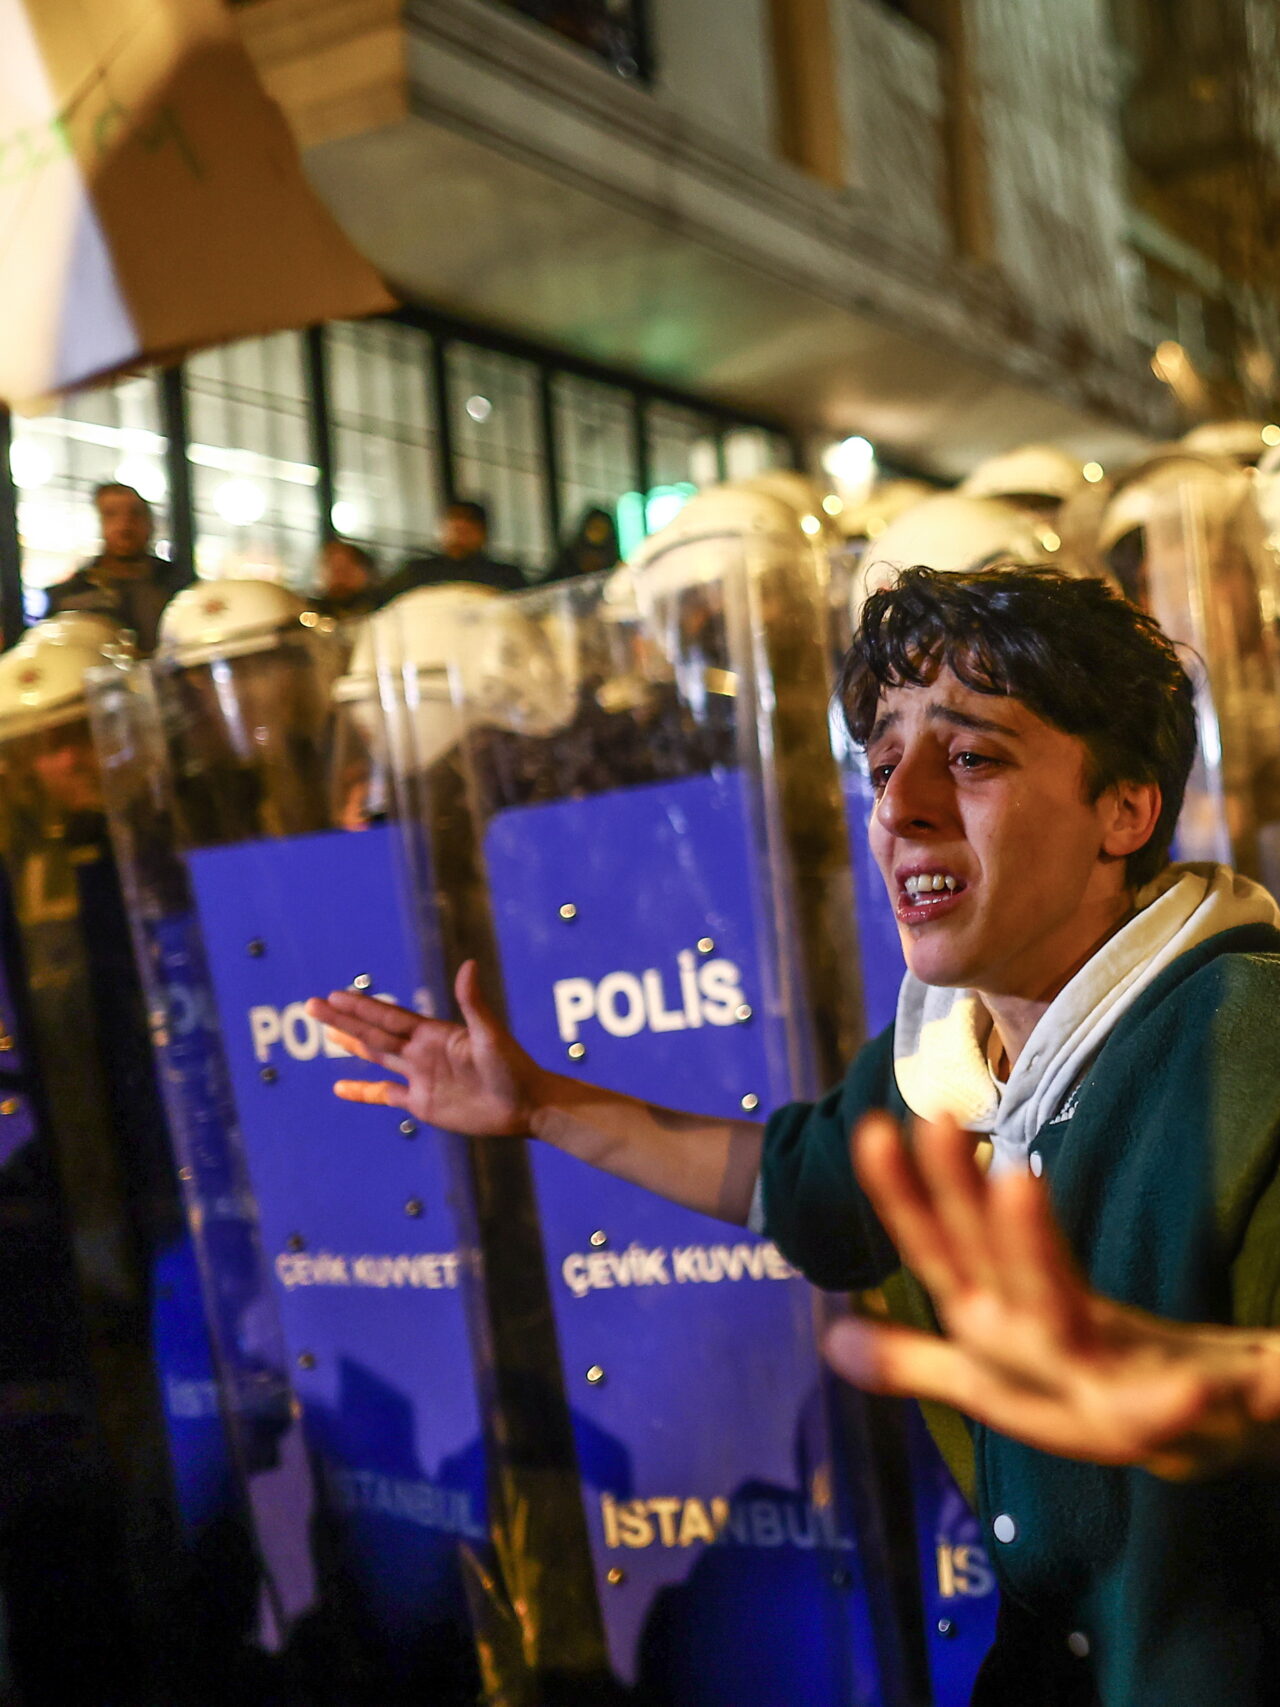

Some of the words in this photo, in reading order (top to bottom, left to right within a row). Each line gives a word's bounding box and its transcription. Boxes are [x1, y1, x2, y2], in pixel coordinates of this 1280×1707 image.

[552, 948, 746, 1043] POLİS
[672, 1240, 800, 1284] KUVVE
[601, 1492, 857, 1551] İSTANBUL
